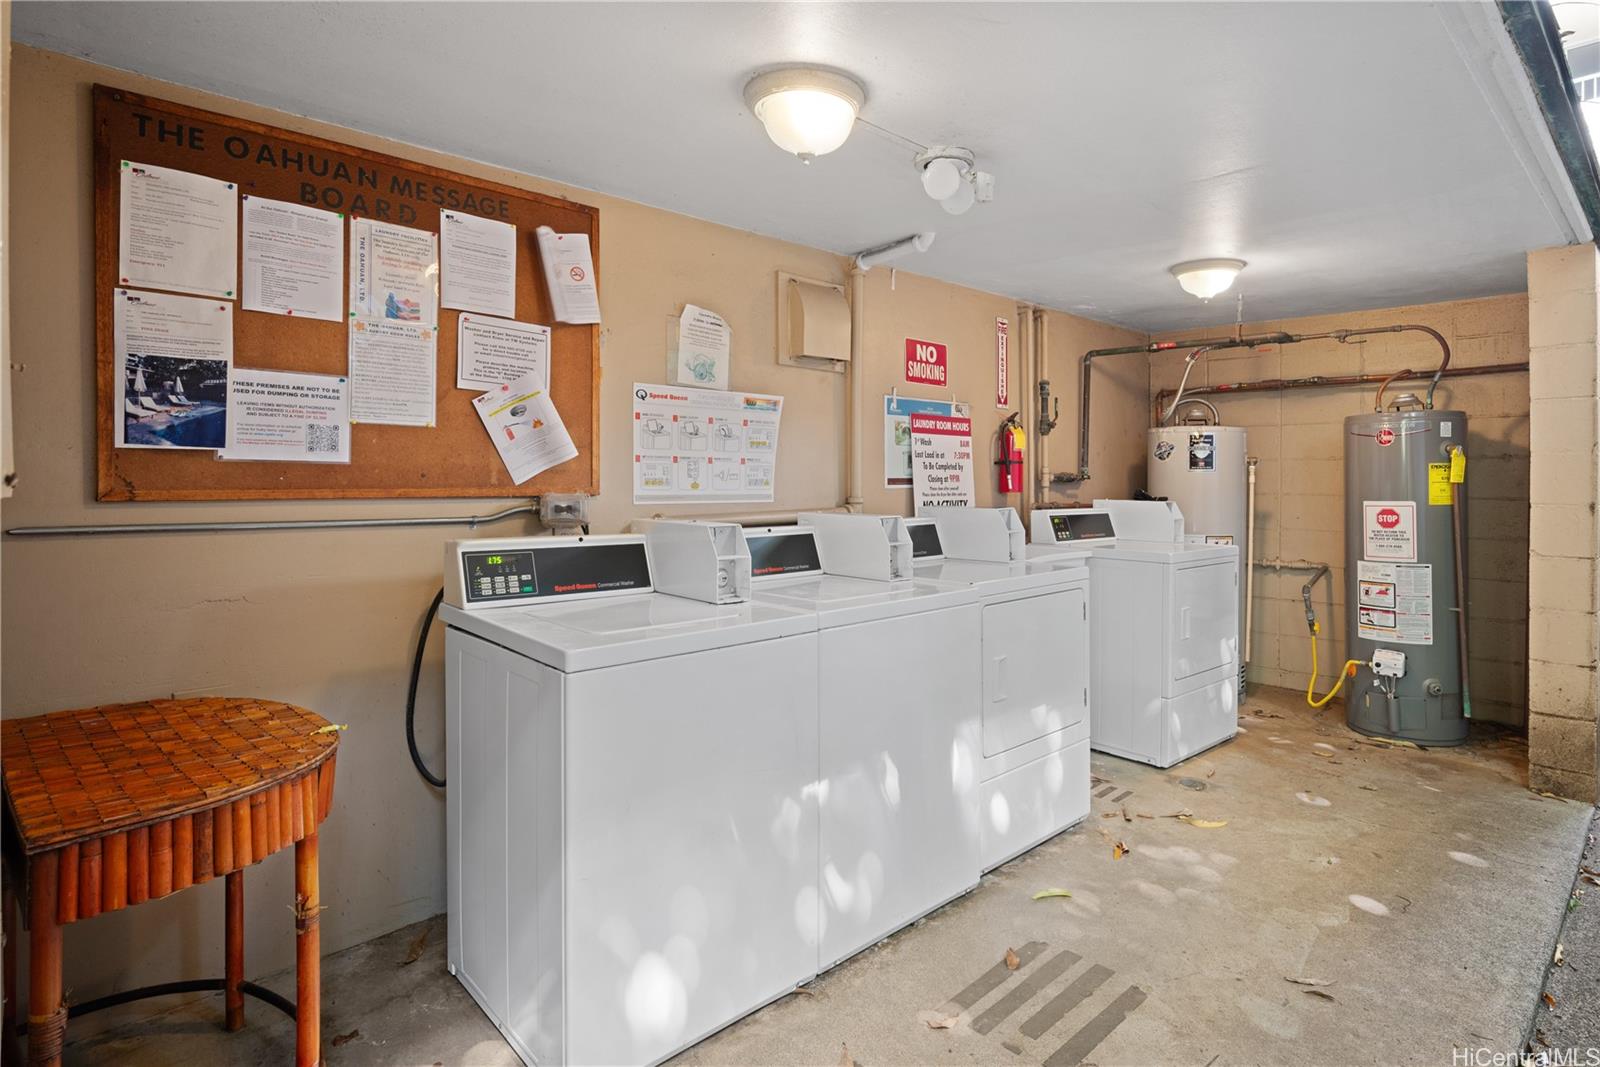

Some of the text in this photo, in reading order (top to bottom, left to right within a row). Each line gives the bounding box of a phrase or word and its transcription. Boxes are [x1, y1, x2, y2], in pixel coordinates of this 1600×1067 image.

[132, 113, 509, 219] THE OAHUAN MESSAGE
[300, 182, 417, 225] BOARD
[998, 325, 1008, 335] FIRE
[916, 344, 937, 363] NO
[908, 360, 945, 381] SMOKING
[232, 380, 254, 388] THESE
[256, 382, 290, 390] PREMISES
[913, 418, 969, 432] LAUNDRY ROOM HOURS
[920, 438, 932, 447] Wash
[959, 440, 970, 448] 8AM
[914, 451, 923, 459] Last
[924, 451, 935, 459] Load
[953, 452, 970, 460] 7:30PM
[923, 462, 964, 473] To Be Completed by
[927, 475, 943, 486] Closing
[949, 475, 960, 483] 9PM
[937, 499, 968, 507] ACTIVITY
[1378, 514, 1398, 523] STOP
[753, 567, 768, 575] Speed
[554, 583, 576, 592] Speed
[575, 582, 597, 590] Queen
[597, 580, 620, 588] Commercial
